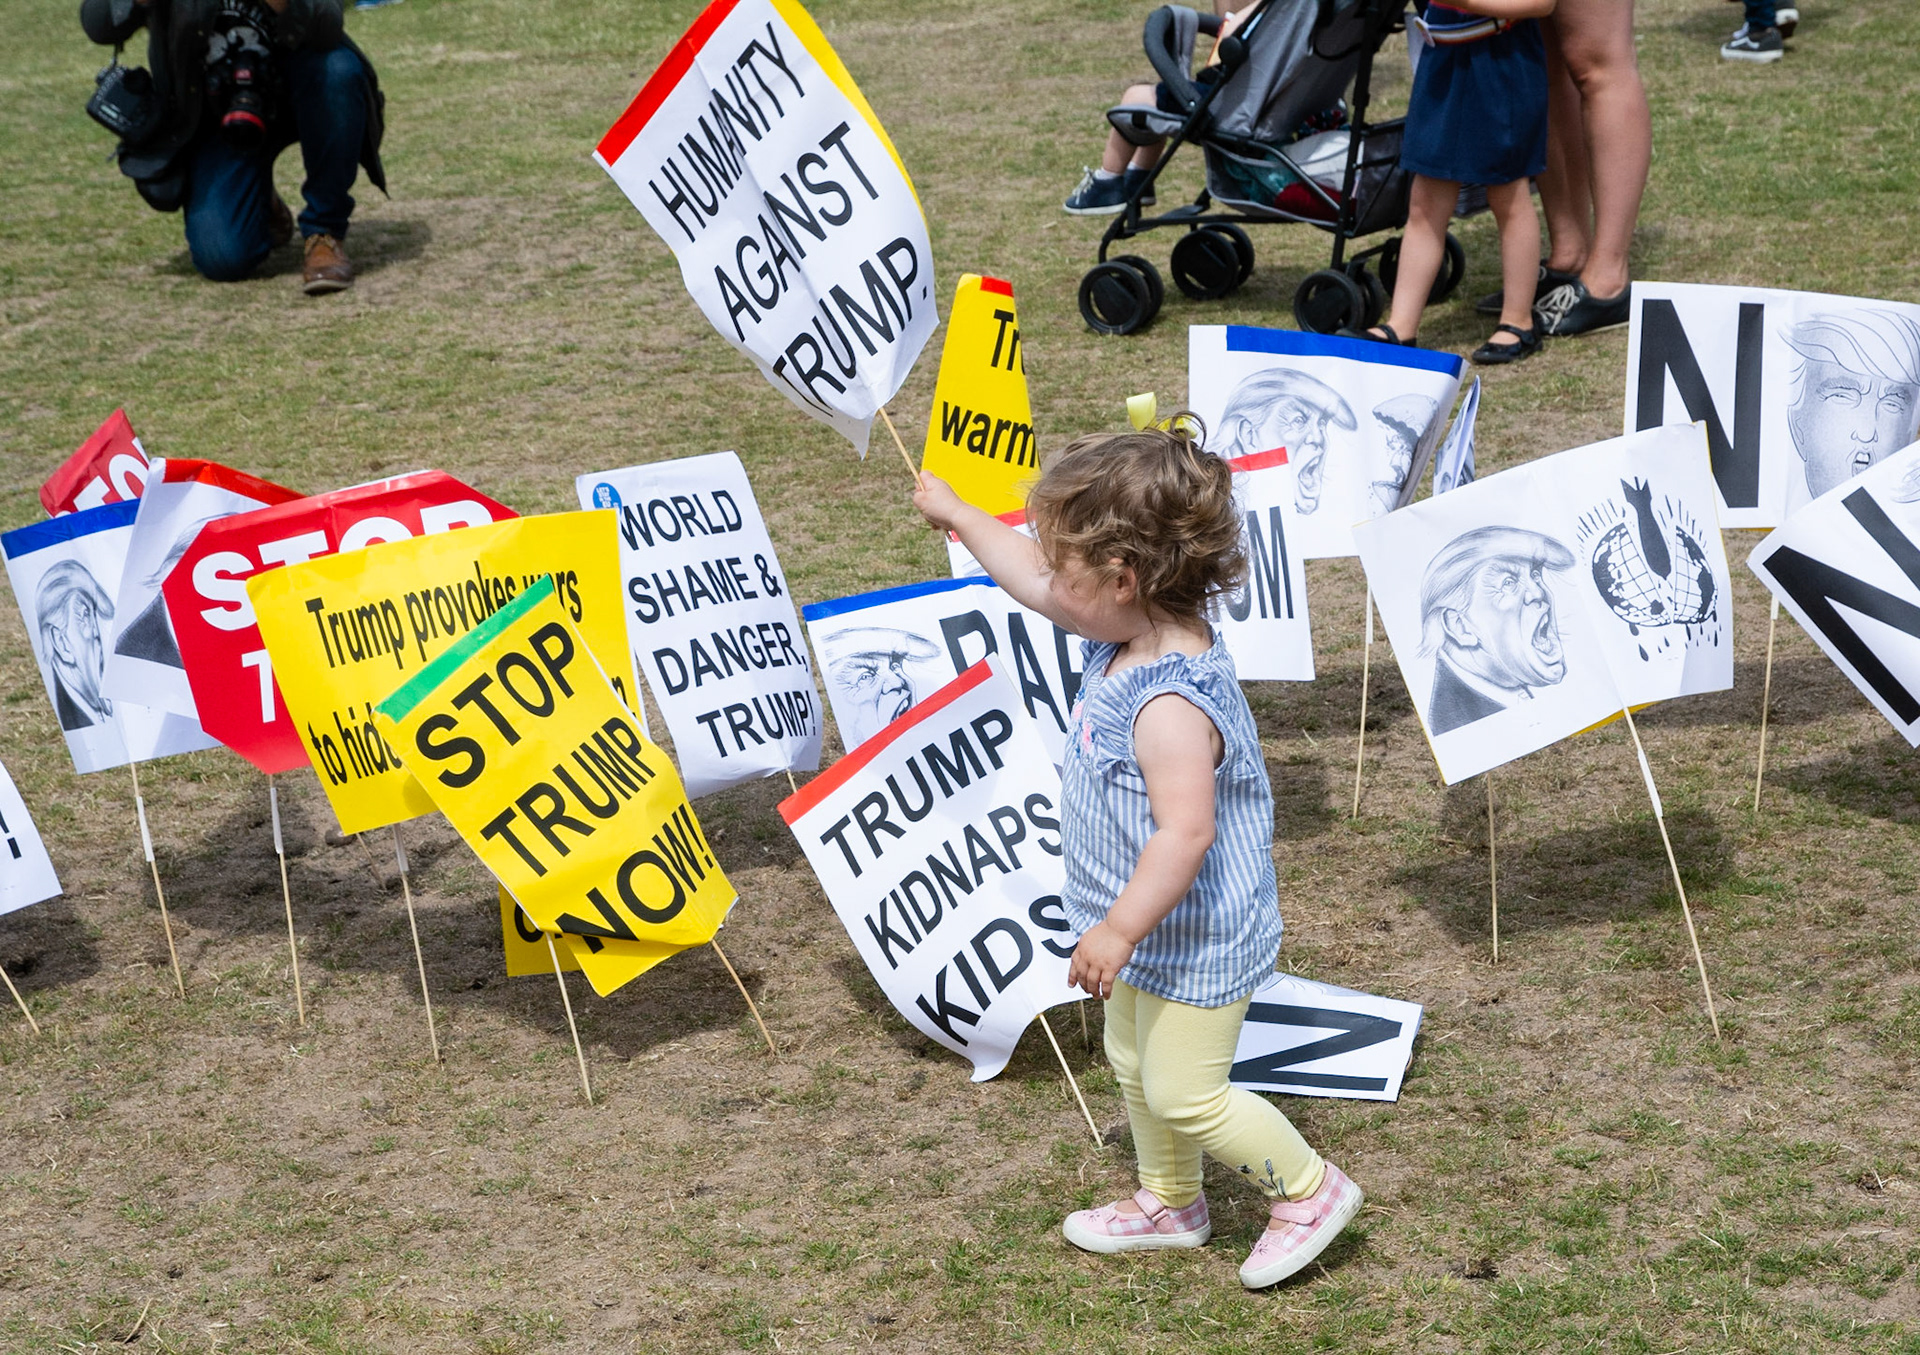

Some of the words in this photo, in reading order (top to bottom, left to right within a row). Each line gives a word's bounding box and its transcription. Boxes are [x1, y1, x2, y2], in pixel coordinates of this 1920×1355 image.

[648, 21, 805, 243] HUMANITY
[990, 308, 1025, 376] Tr
[941, 401, 1041, 469] warm
[1635, 298, 1764, 508] N
[621, 490, 743, 551] WORLD
[305, 597, 404, 670] Trump
[628, 557, 758, 624] SHAME
[754, 553, 783, 597] &
[415, 621, 575, 788] STOP
[652, 622, 808, 696] DANGER,
[307, 721, 348, 787] to
[696, 690, 816, 758] TRUMP!
[480, 716, 656, 877] TRUMP
[820, 708, 1013, 878] TRUMP
[555, 803, 714, 954] NOW!
[864, 793, 1063, 970] KIDNAPS
[916, 894, 1079, 1046] KIDS
